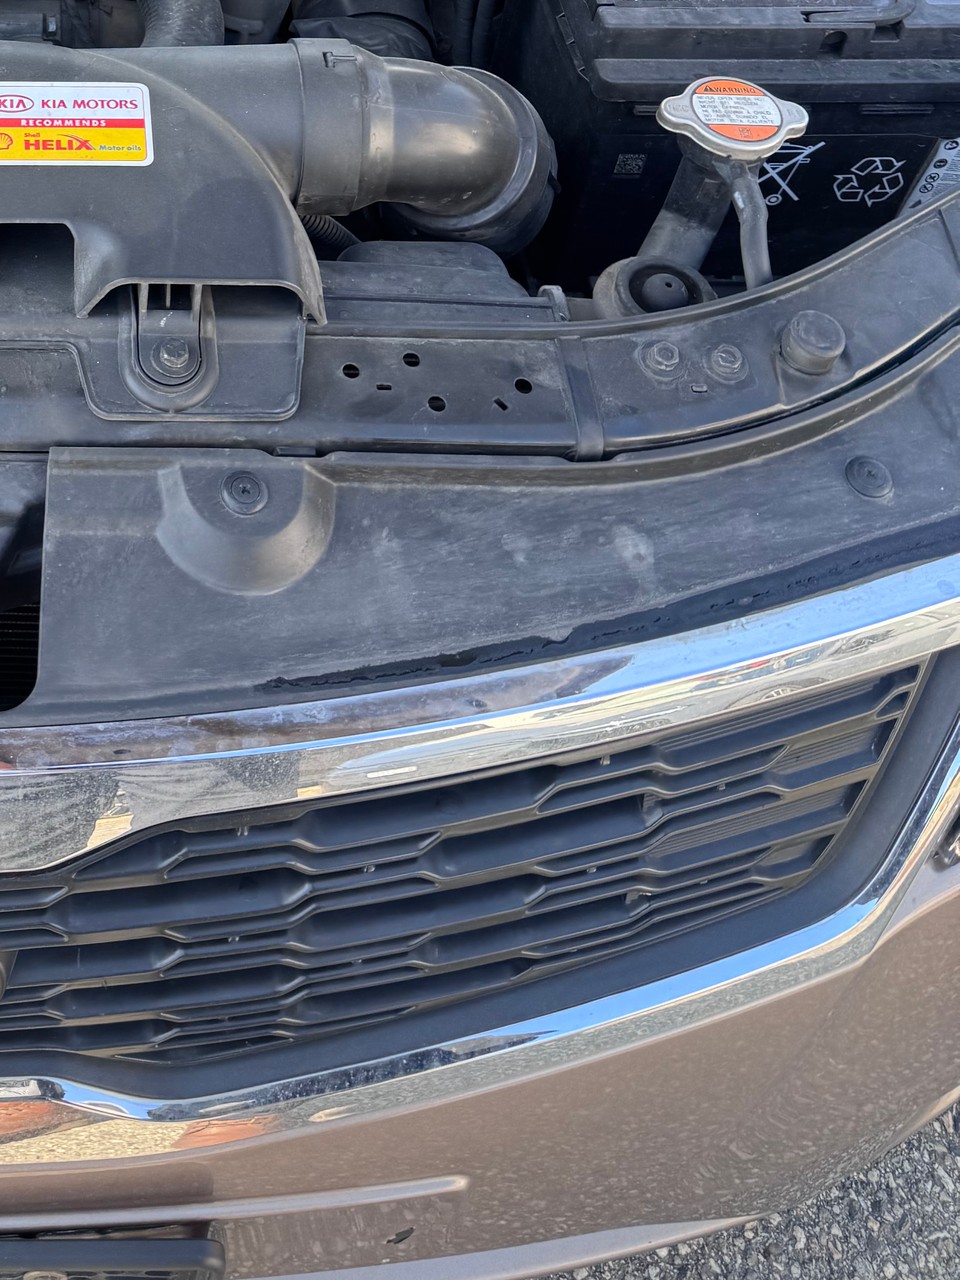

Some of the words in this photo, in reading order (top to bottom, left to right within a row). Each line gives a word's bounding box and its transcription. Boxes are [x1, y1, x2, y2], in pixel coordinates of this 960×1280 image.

[41, 99, 68, 109] KIA
[72, 99, 139, 110] MOTORS
[20, 119, 107, 127] RECOMMENDS
[24, 138, 94, 151] HELIX
